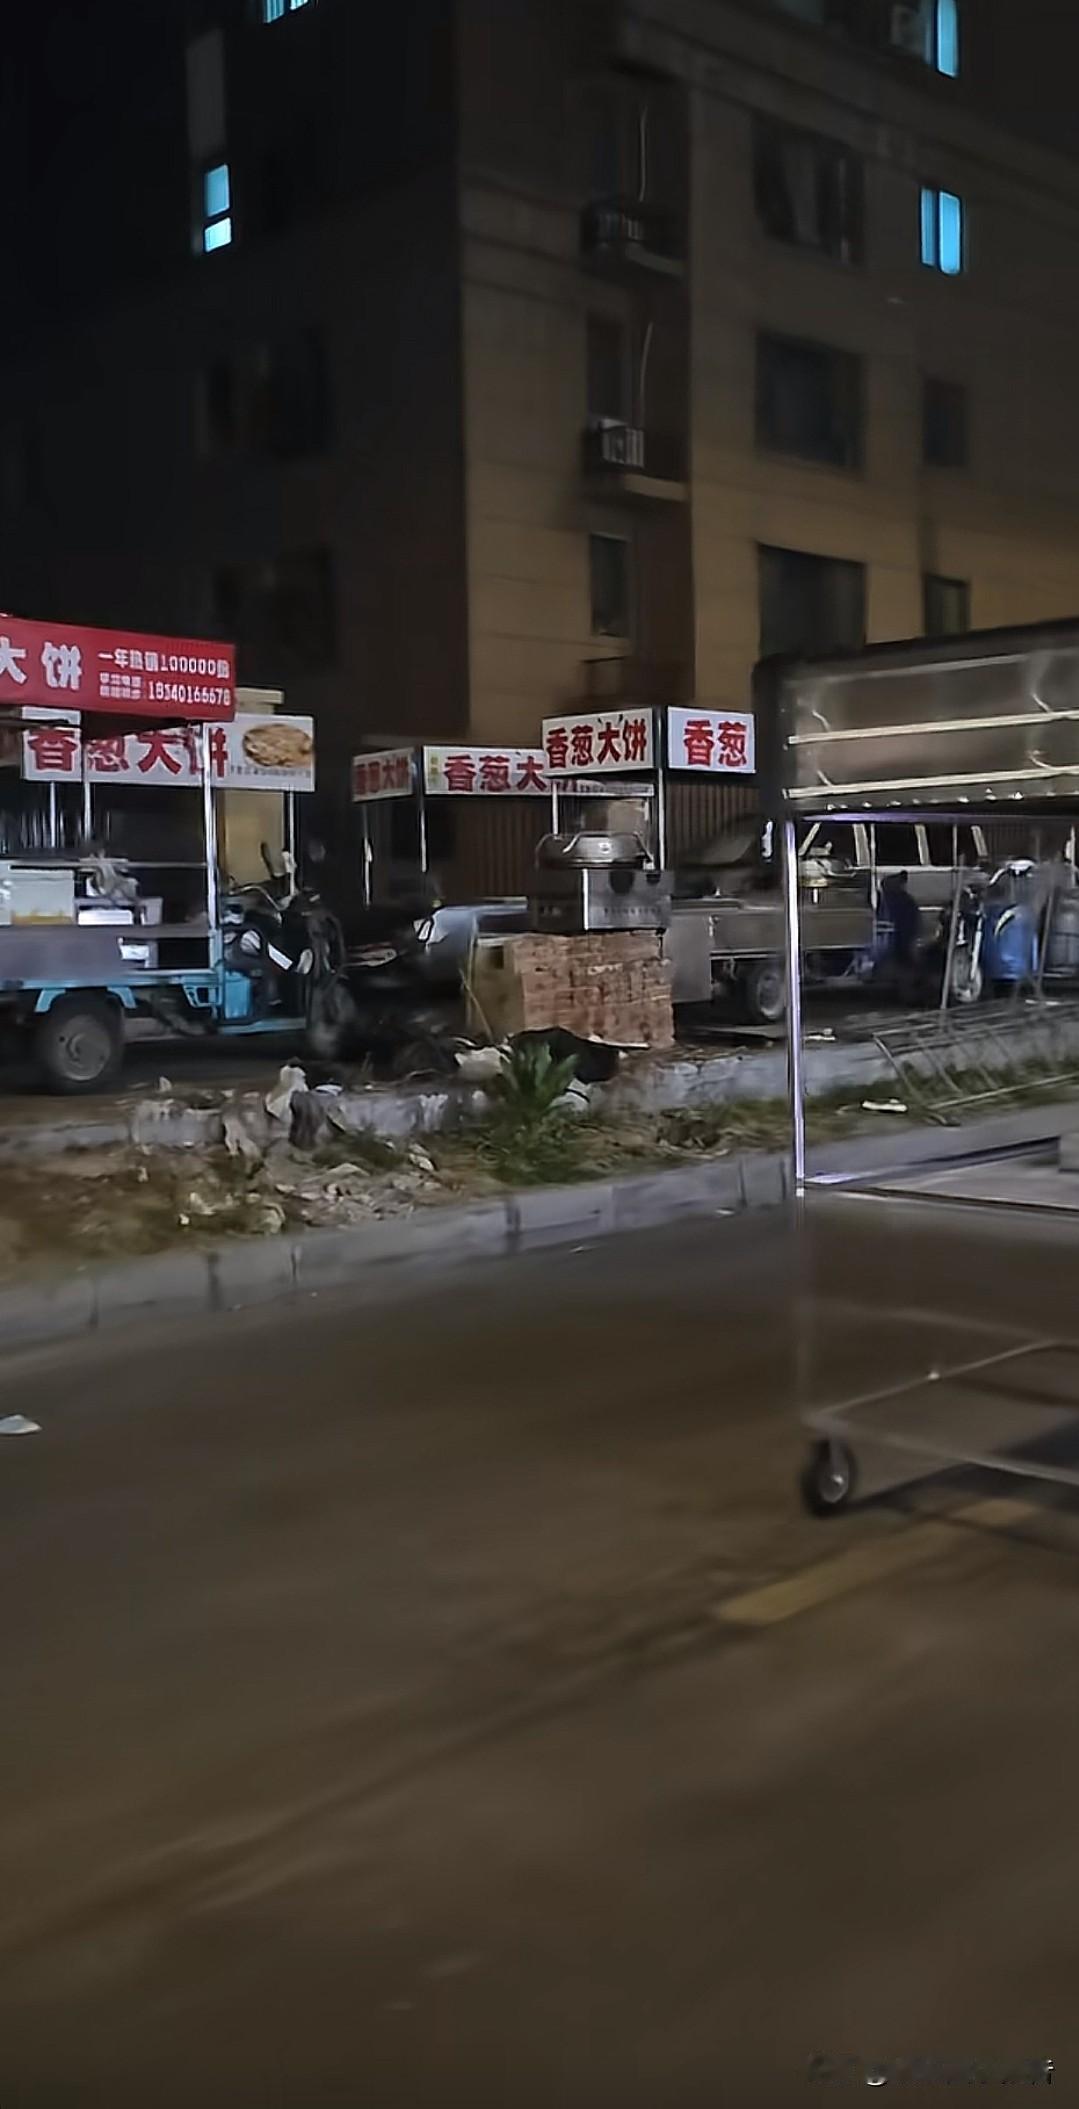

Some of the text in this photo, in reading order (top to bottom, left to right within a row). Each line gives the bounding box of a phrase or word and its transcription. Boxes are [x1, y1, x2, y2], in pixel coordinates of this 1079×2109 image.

[0, 635, 82, 691] 大饼
[546, 718, 648, 769] 香葱大饼
[683, 719, 748, 768] 香葱
[444, 755, 577, 794] 香葱大
